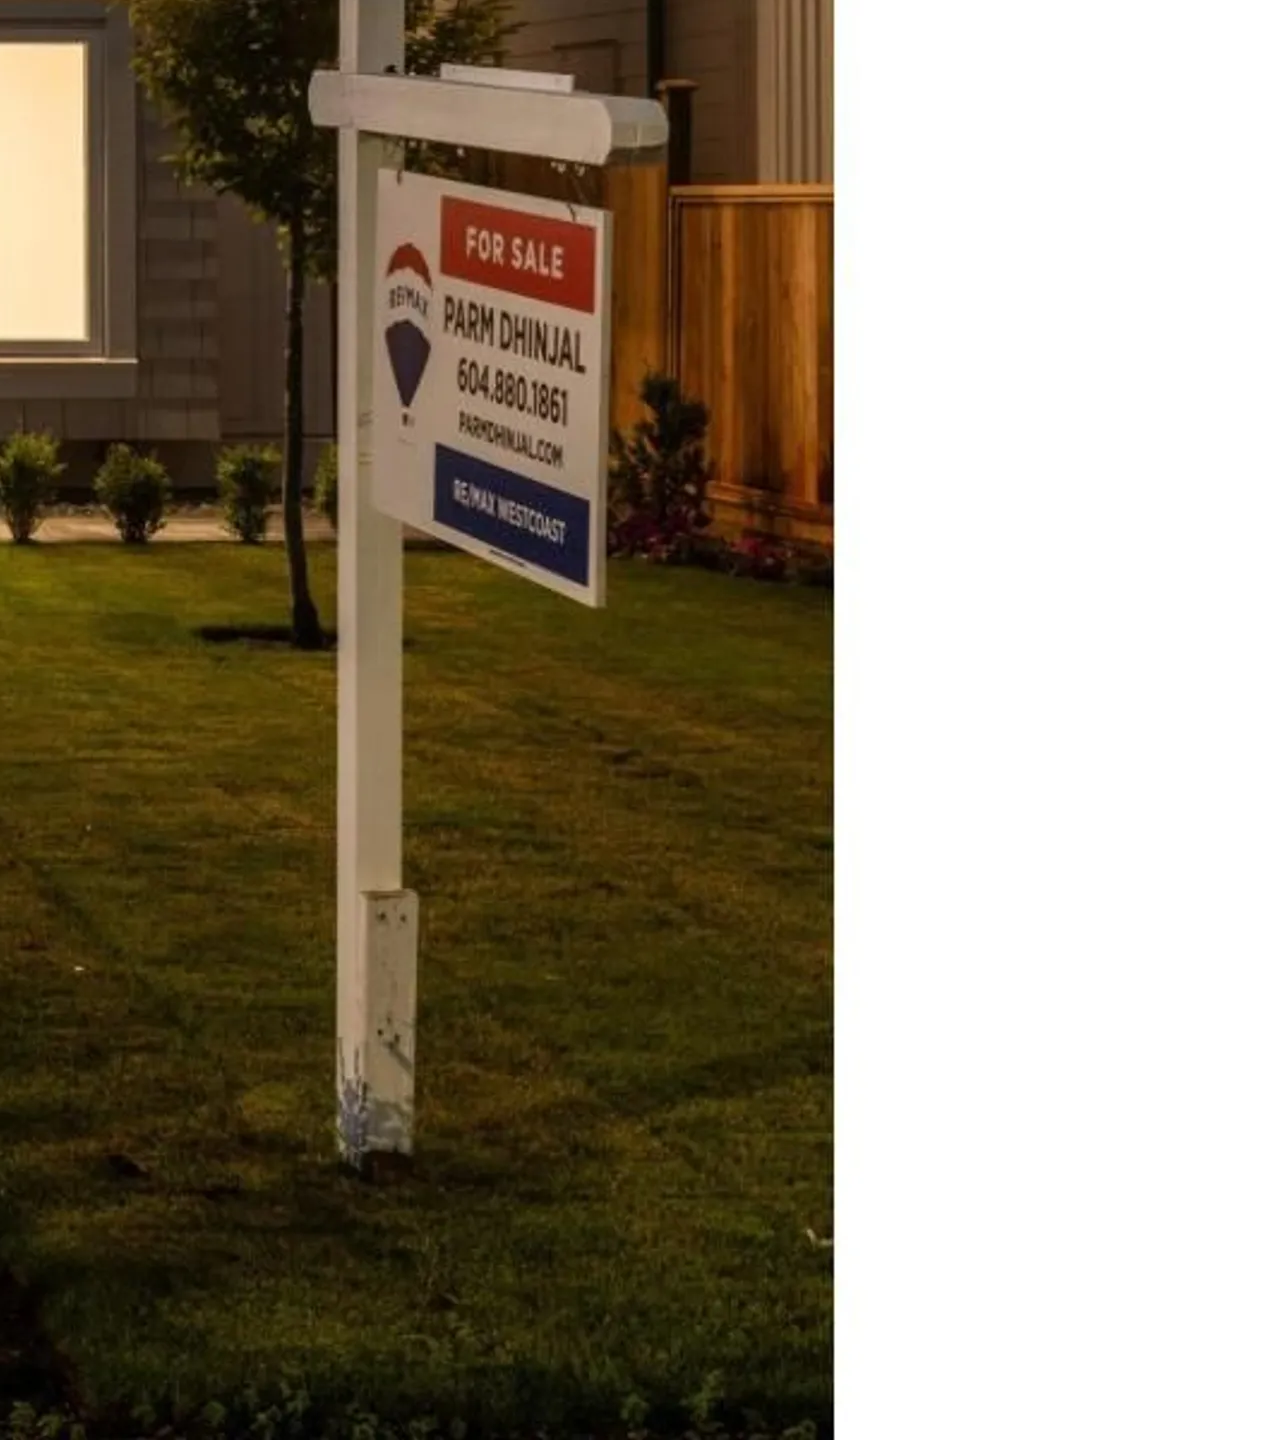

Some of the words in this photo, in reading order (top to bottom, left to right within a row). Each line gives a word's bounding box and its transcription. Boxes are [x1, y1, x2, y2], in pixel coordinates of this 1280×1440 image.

[464, 225, 504, 267] FOR
[510, 236, 565, 280] SALE
[389, 284, 429, 317] RE/MAX
[443, 294, 495, 347] PARM
[499, 311, 587, 375] DHINJAL
[456, 357, 569, 427] 604.880.1861
[457, 410, 565, 469] PARMDHINJAL.COM
[452, 478, 497, 516] RE/MAX
[497, 495, 567, 546] WESTCOAST
